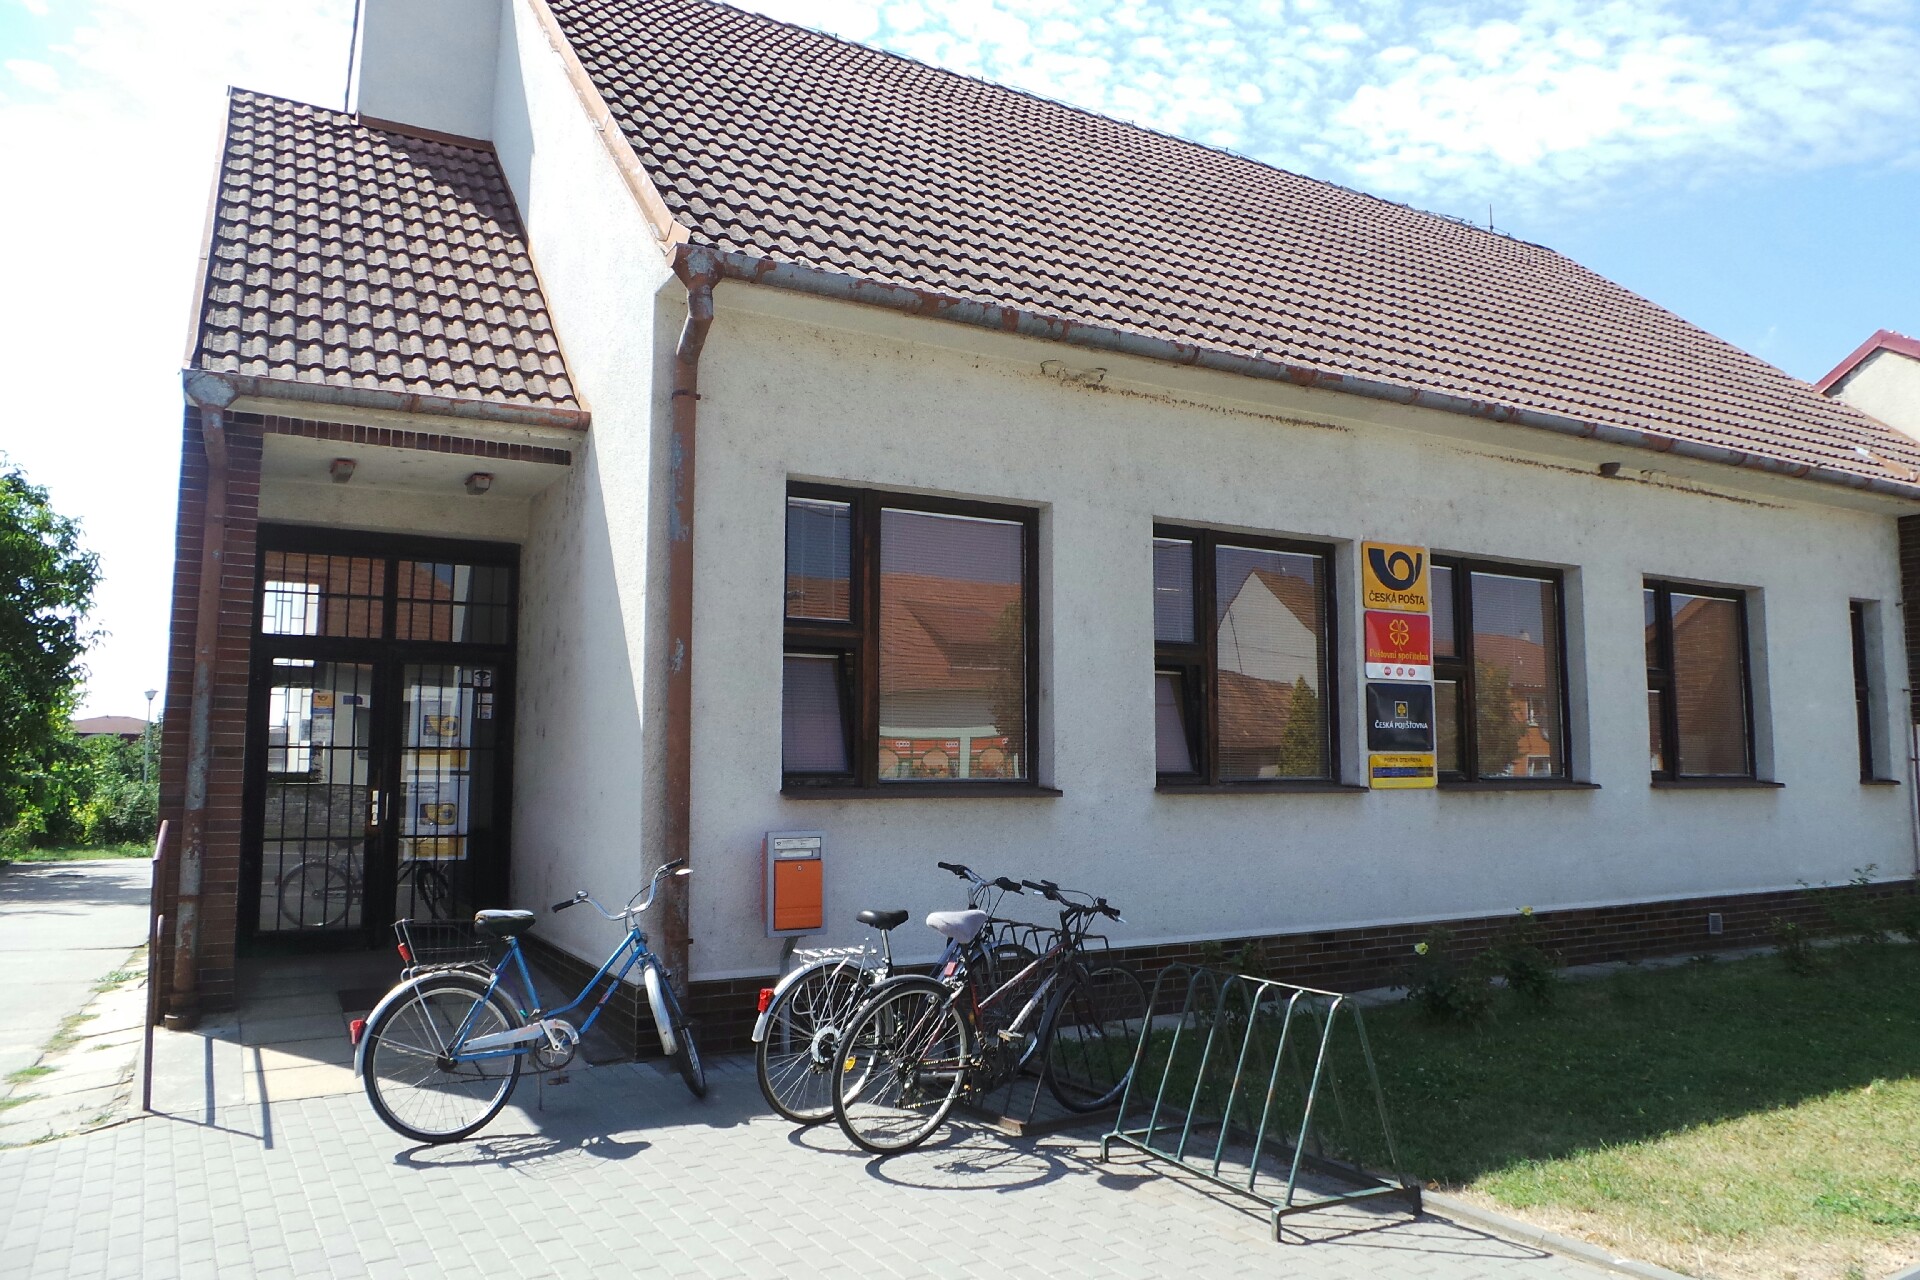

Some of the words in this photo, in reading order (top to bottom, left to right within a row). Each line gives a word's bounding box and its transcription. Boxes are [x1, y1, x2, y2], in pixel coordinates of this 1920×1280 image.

[1368, 590, 1397, 603] ČESKÁ
[1398, 593, 1425, 605] POŠTA
[1369, 648, 1397, 659] Poštovní
[1398, 651, 1429, 661] spořitelna
[1374, 719, 1393, 729] ČESKÁ
[1394, 720, 1428, 730] POJIŠŤOVNA
